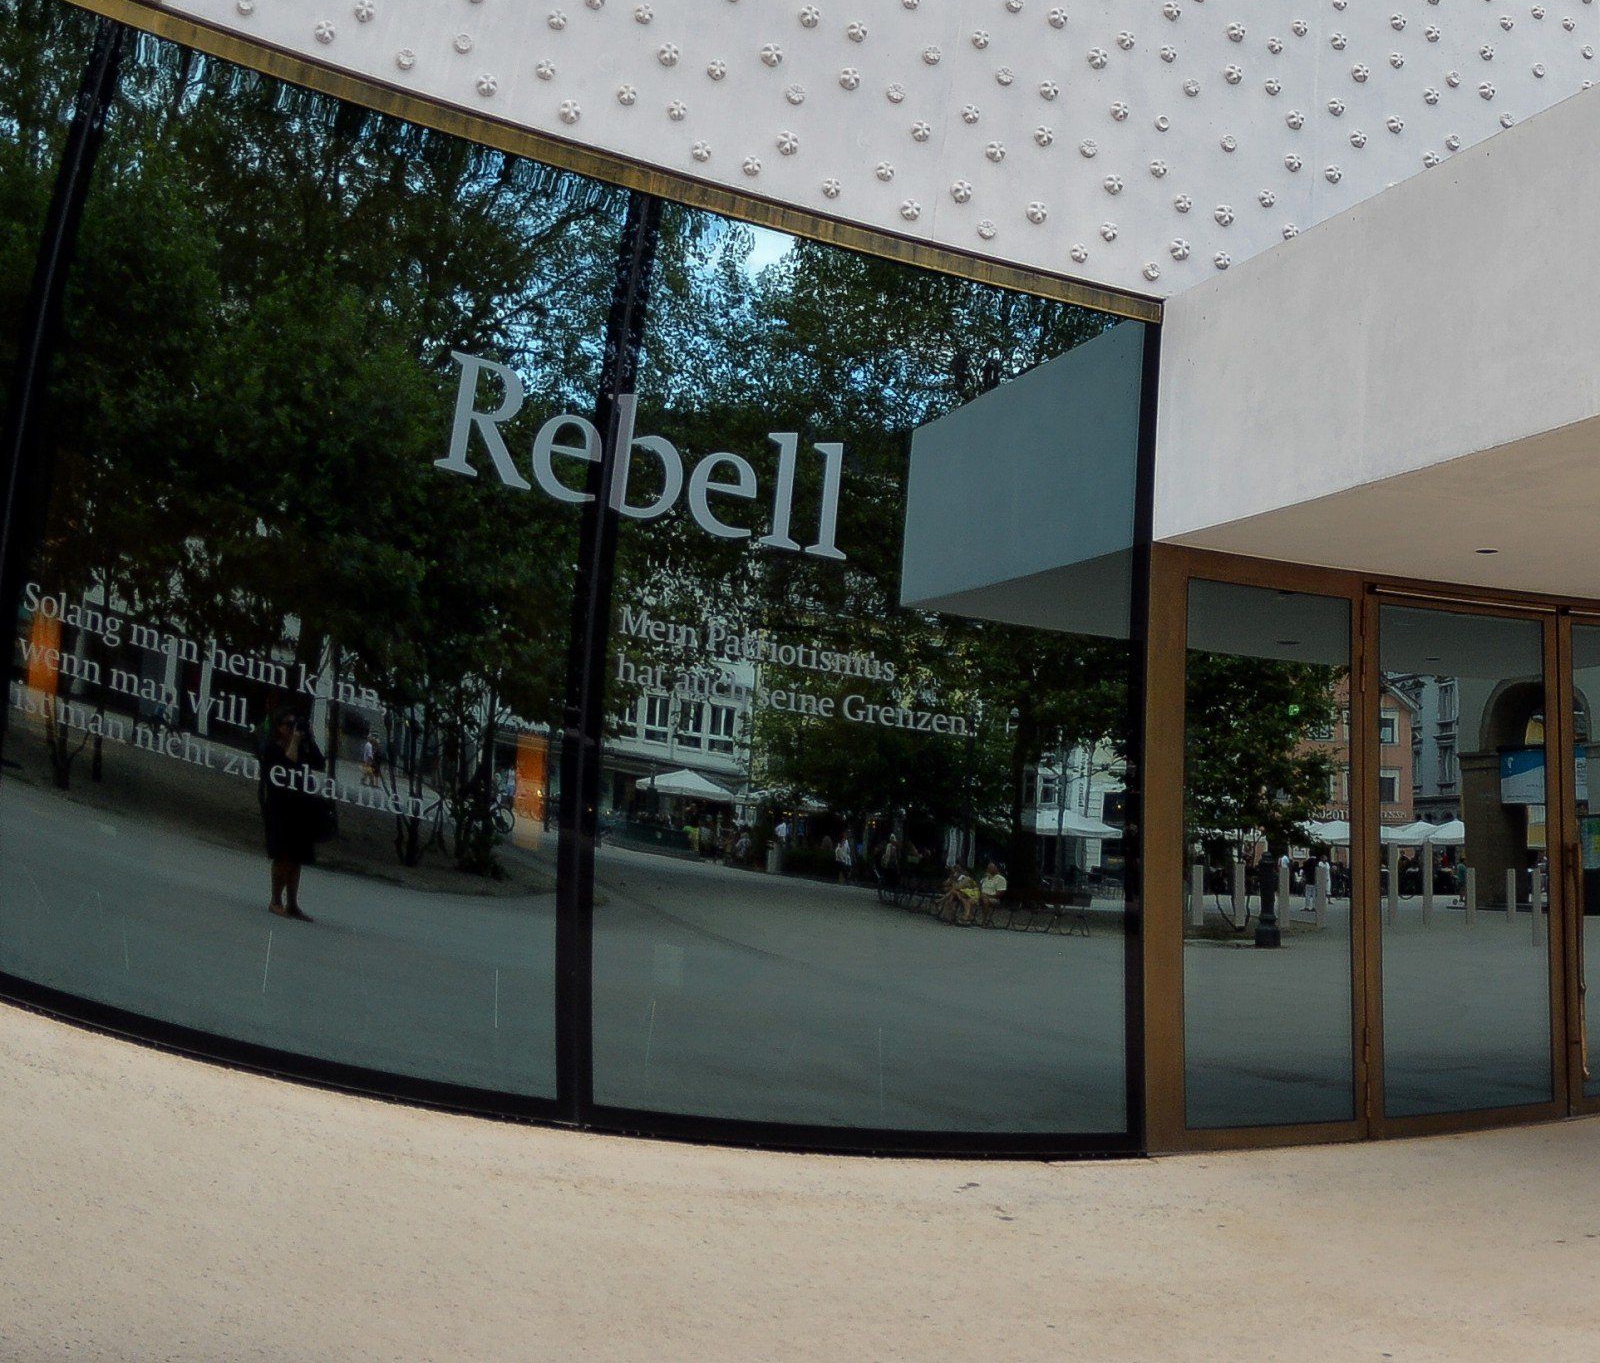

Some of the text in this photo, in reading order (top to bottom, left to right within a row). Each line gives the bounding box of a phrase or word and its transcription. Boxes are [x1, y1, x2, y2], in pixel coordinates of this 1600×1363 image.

[434, 350, 847, 560] Rebell
[18, 637, 256, 733] wenn man will,
[23, 582, 123, 647] Solang
[129, 623, 199, 664] man
[204, 638, 289, 689] heim
[619, 605, 895, 682] Mein Patriotismus
[14, 679, 50, 718] ist
[56, 701, 127, 744] man
[134, 722, 216, 768] nicht
[222, 749, 261, 781] zu
[616, 653, 977, 736] hat auch seine Grenzen.
